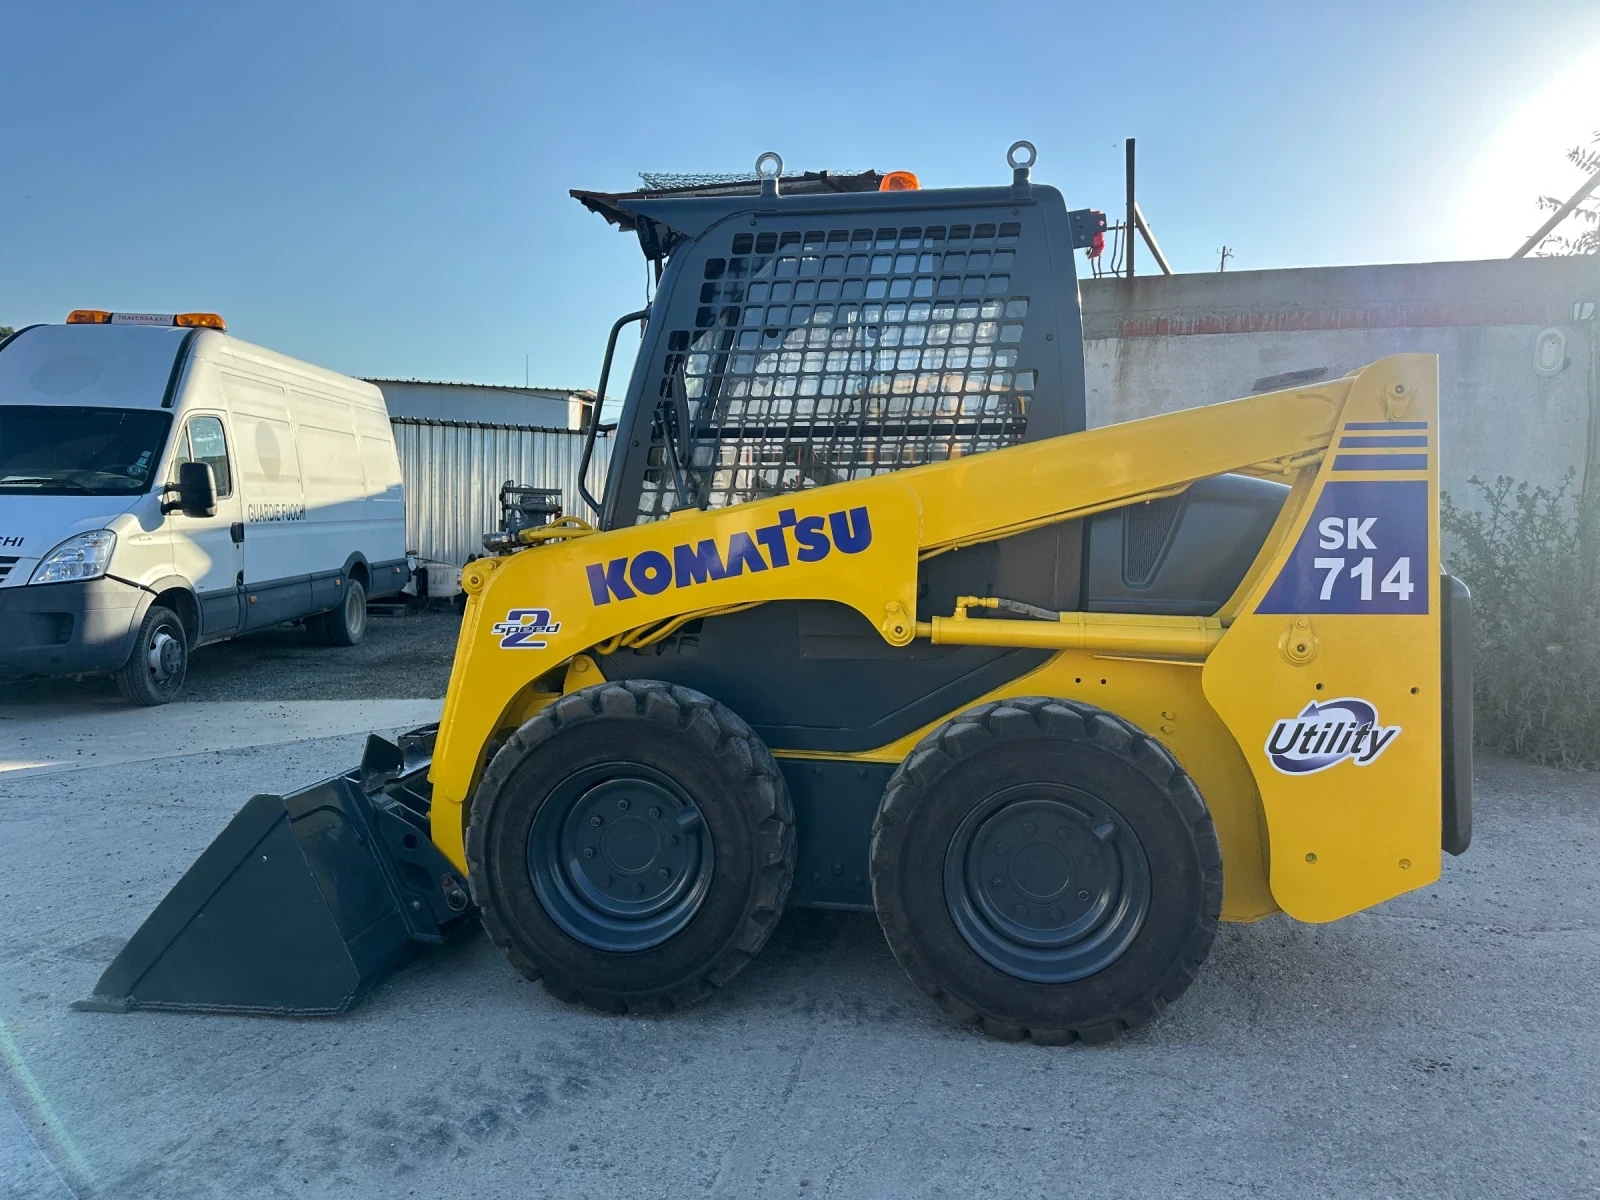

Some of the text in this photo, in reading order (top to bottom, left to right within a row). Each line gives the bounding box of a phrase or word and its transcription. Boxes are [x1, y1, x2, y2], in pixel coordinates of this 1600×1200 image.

[247, 503, 306, 522] GUARDIE FUOCHI
[1318, 516, 1378, 550] SK
[585, 506, 873, 606] KOMATSU
[1314, 556, 1414, 601] 714
[493, 623, 560, 636] Speed
[500, 609, 551, 649] 2
[1268, 722, 1396, 762] Utility
